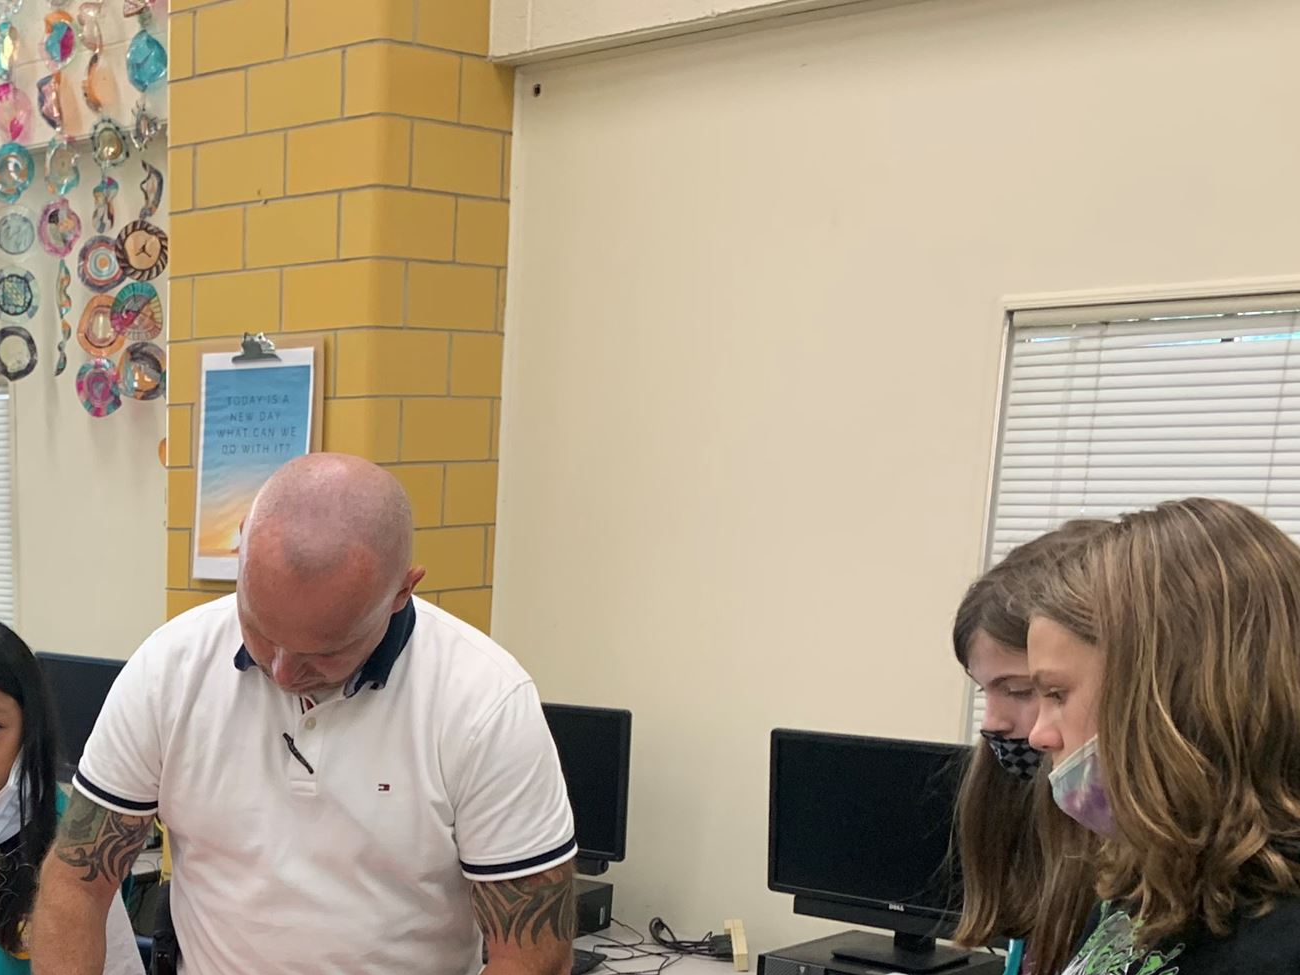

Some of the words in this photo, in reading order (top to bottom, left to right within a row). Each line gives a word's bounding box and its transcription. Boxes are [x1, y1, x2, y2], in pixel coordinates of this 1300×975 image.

[227, 395, 262, 406] TODAY
[267, 394, 278, 405] IS
[282, 394, 290, 404] A
[229, 411, 254, 422] NEW
[260, 411, 281, 421] DAY
[216, 428, 248, 438] WHAT
[253, 427, 275, 438] CAN
[281, 426, 297, 437] WE
[221, 444, 237, 455] DO
[242, 444, 269, 454] WITH
[274, 443, 291, 453] IT?
